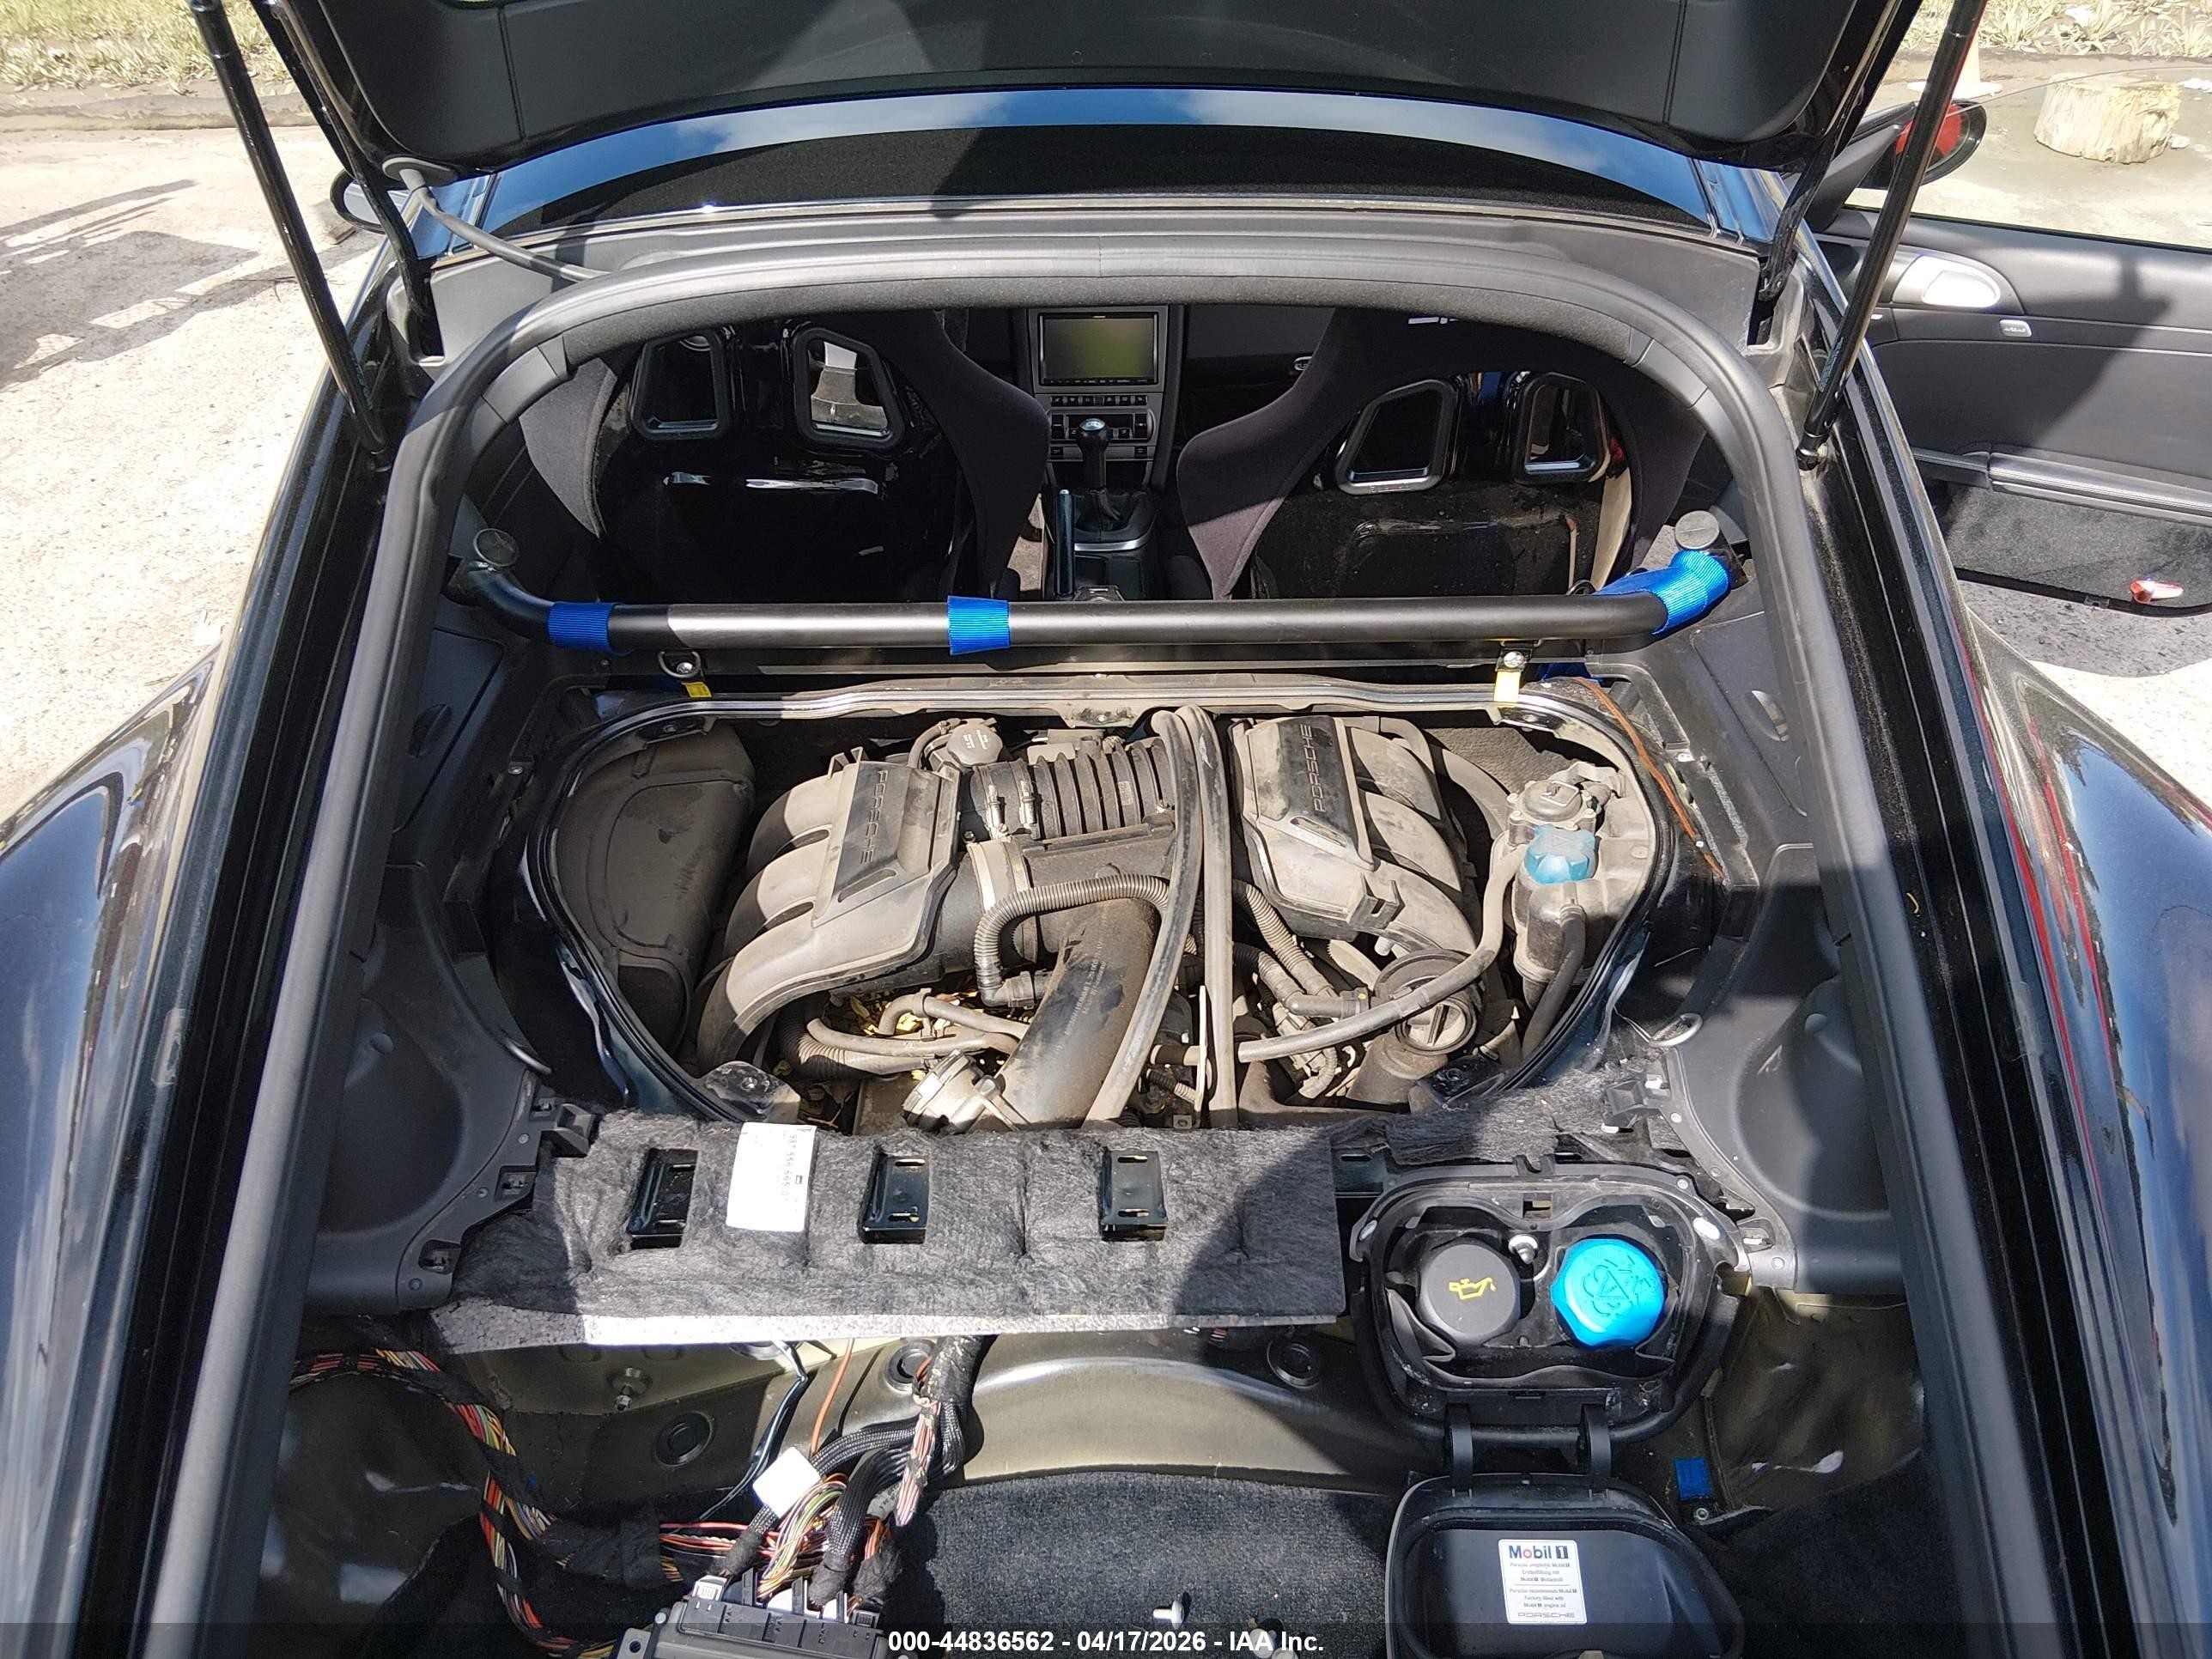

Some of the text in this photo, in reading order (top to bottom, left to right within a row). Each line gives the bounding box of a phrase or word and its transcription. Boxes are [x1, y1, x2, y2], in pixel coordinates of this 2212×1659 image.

[1299, 724, 1327, 812] PORSCHE
[860, 769, 889, 864] PORSCHE
[1509, 1546, 1569, 1559] Mobil 1
